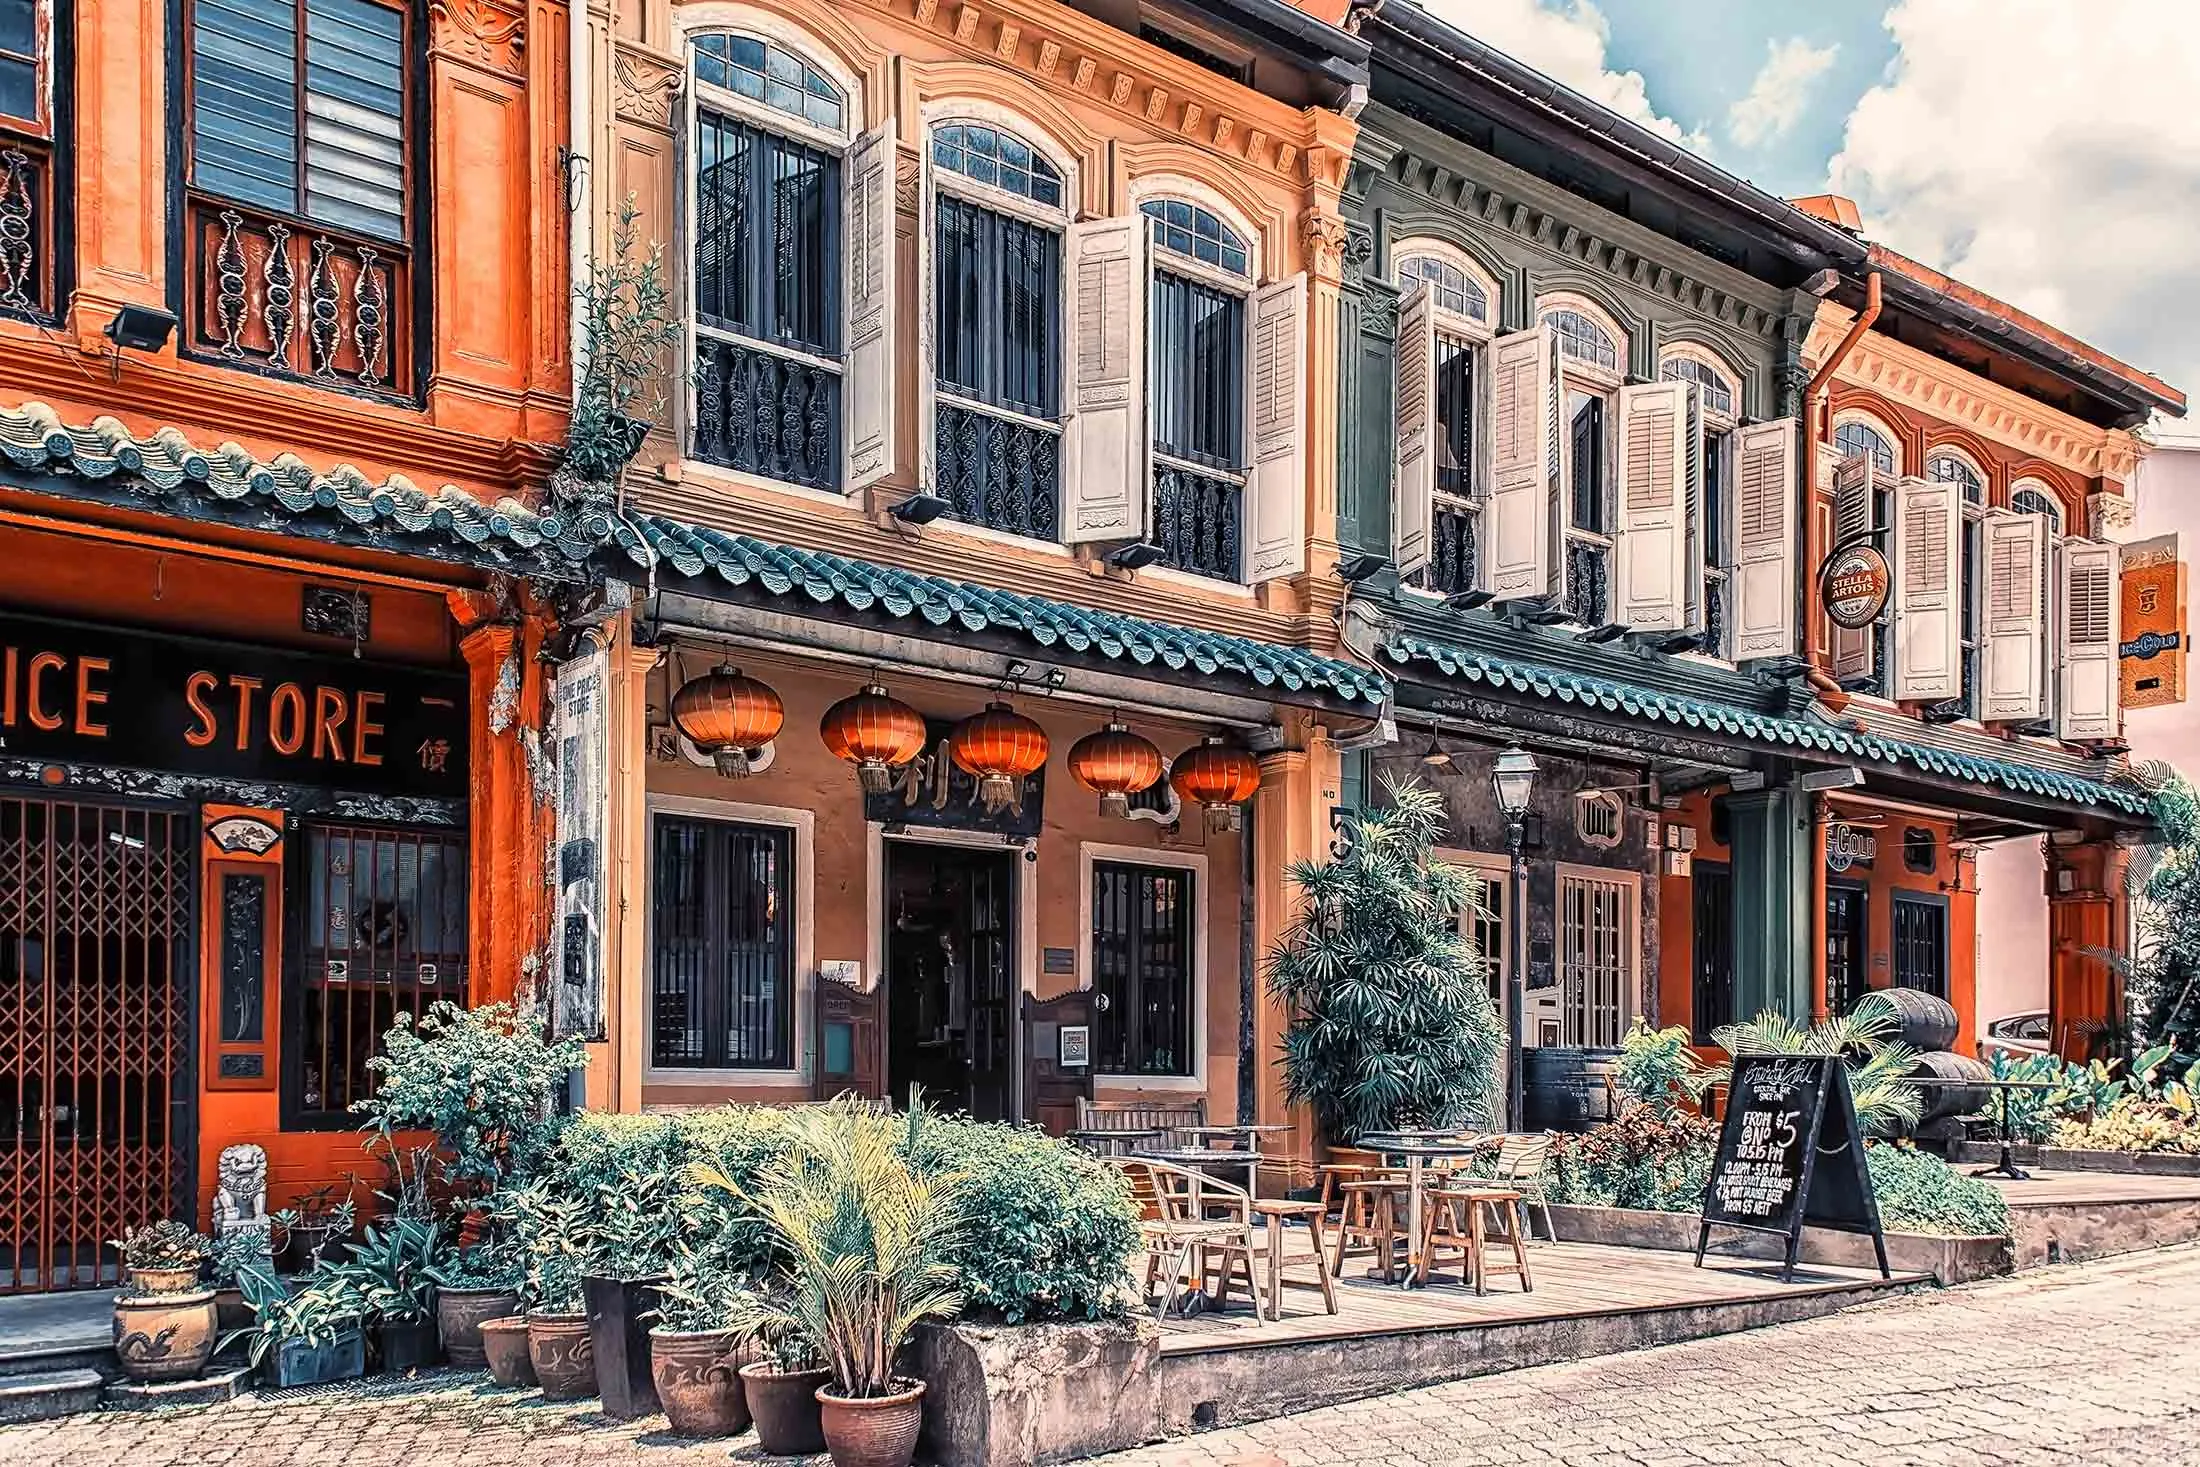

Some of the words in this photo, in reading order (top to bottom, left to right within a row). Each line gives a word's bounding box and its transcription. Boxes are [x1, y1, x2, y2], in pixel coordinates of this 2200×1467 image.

[1832, 574, 1872, 590] STELLA
[1832, 582, 1874, 599] ARTOIS
[2140, 635, 2176, 651] COLD
[562, 682, 575, 702] ONE
[576, 673, 597, 697] PRICE
[568, 695, 590, 719] STORE
[183, 670, 386, 766] STORE
[1322, 790, 1335, 799] NO
[1329, 806, 1355, 860] 5
[1837, 824, 1877, 859] COLD
[1742, 1111, 1772, 1127] FROM
[1776, 1110, 1800, 1148] $5
[1767, 1142, 1785, 1162] PM
[1770, 1163, 1784, 1177] PM
[1723, 1199, 1742, 1213] FROM
